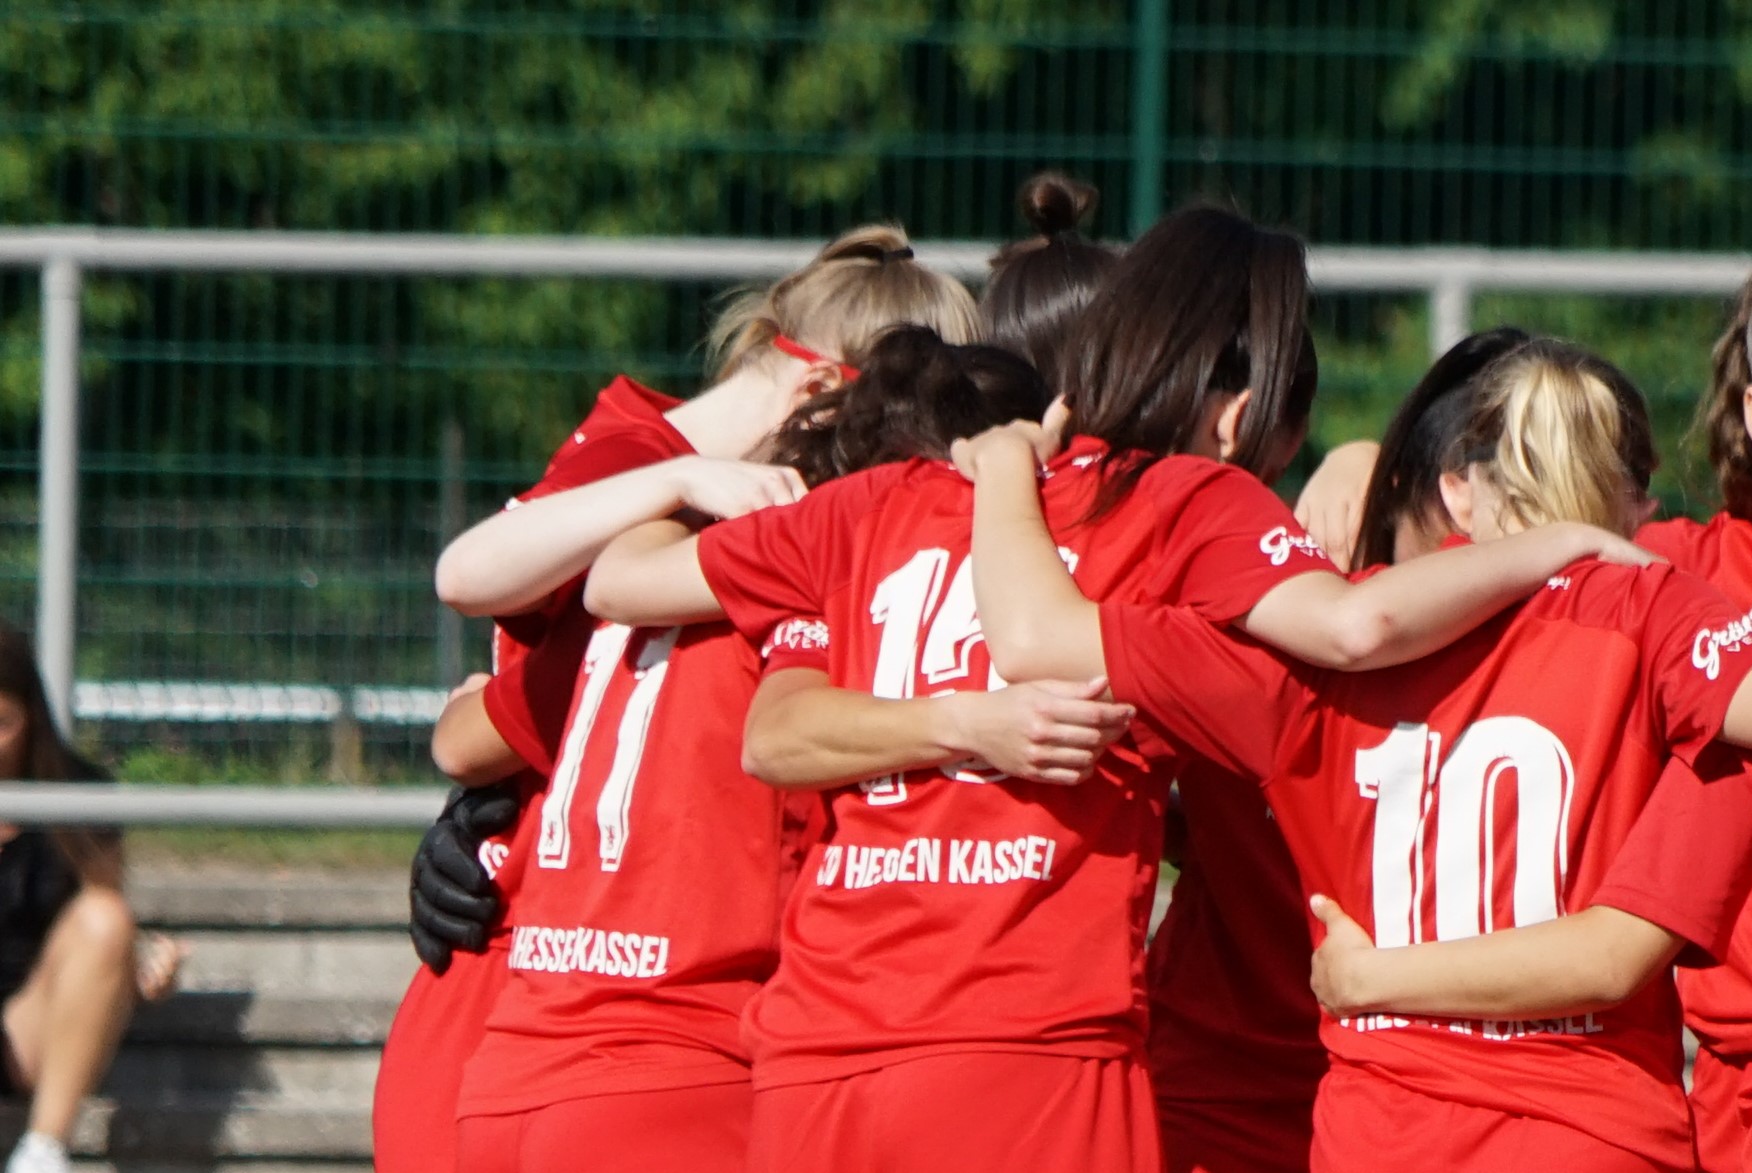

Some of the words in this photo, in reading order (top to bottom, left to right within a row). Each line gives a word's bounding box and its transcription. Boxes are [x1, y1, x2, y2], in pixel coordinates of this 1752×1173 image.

[537, 625, 680, 872] 11
[948, 835, 1056, 885] KASSEL
[1355, 716, 1575, 949] 10
[512, 926, 575, 973] HESSE
[570, 927, 670, 978] KASSEL
